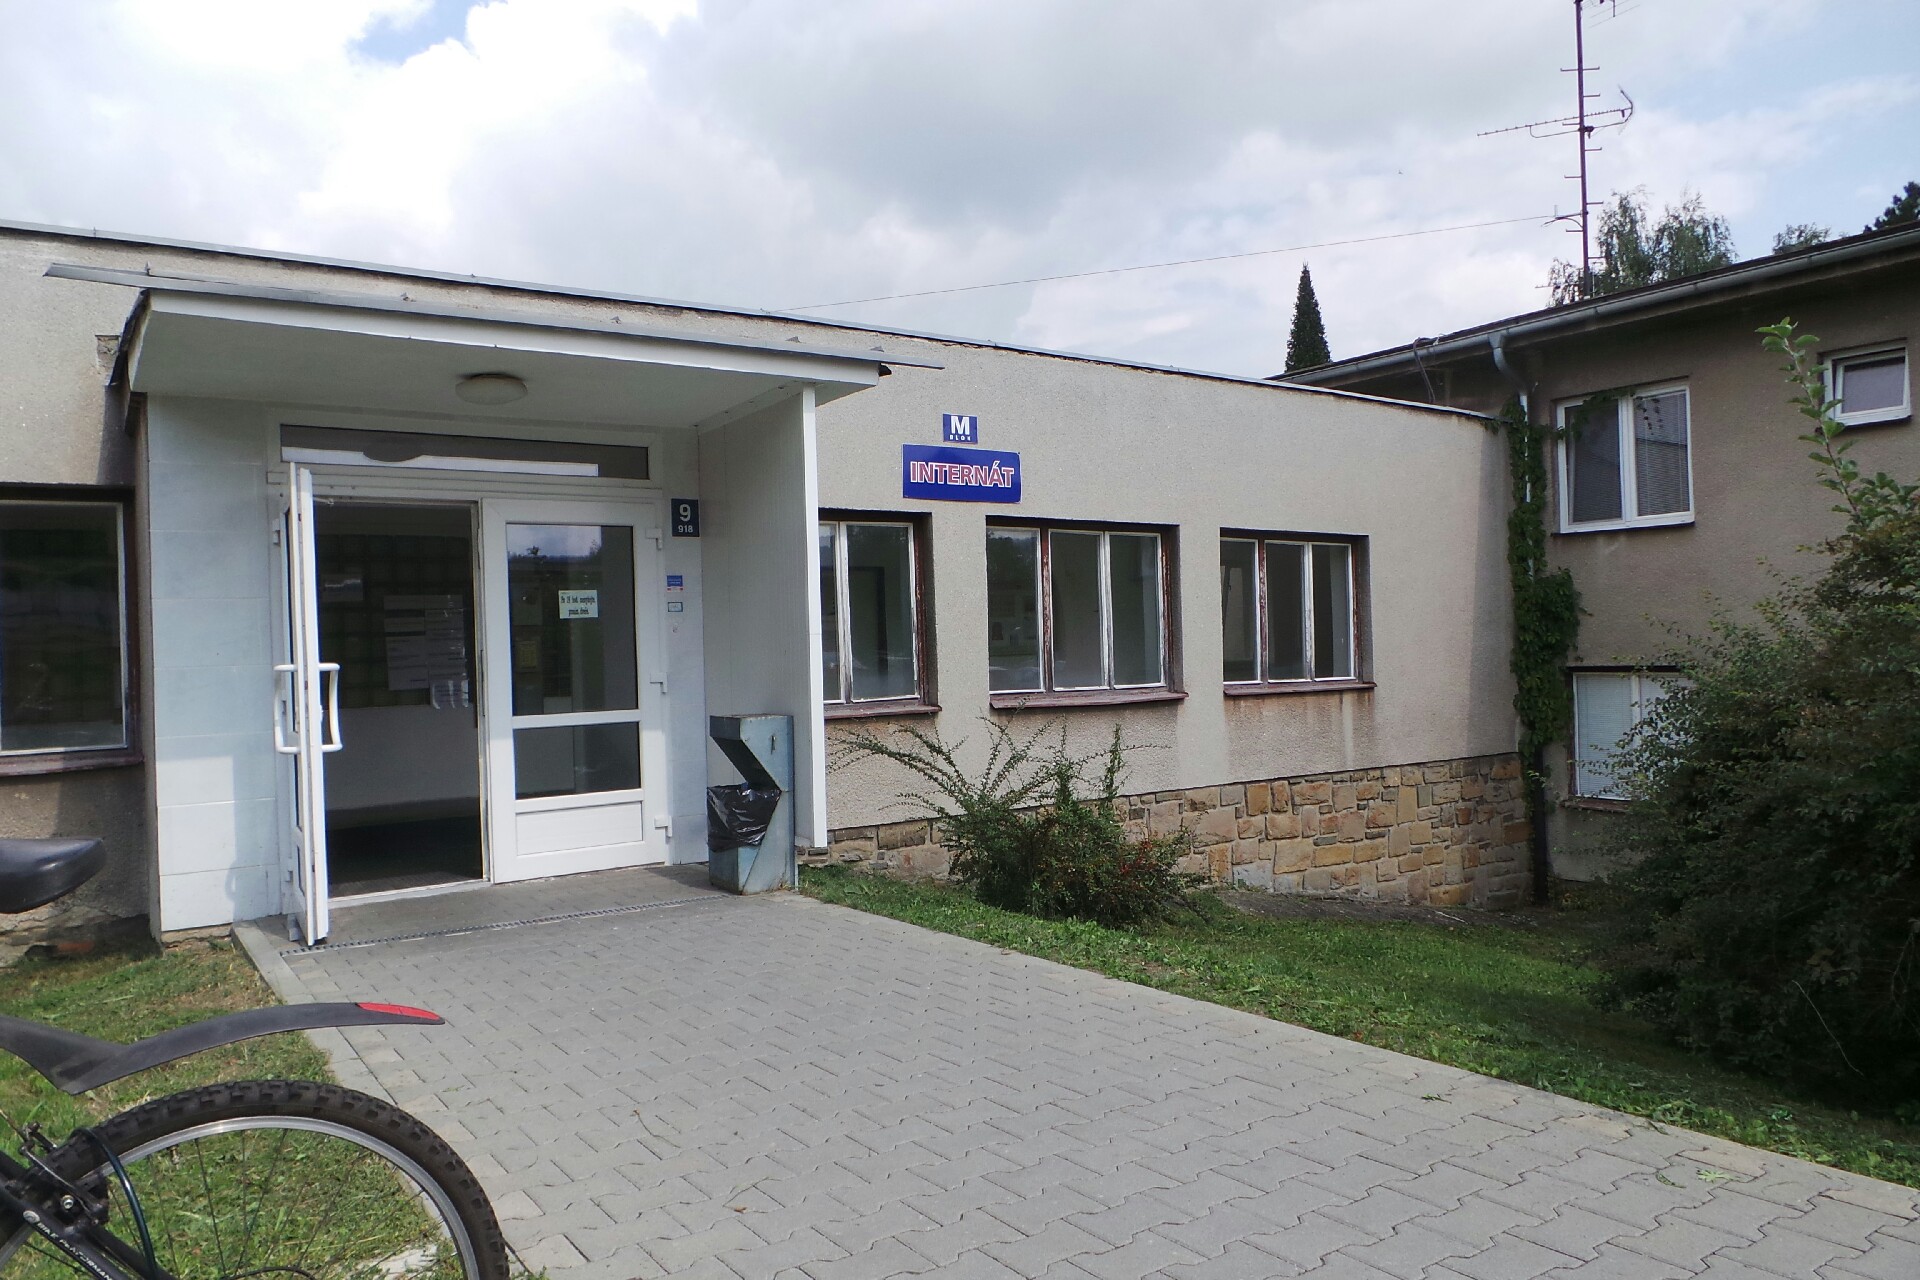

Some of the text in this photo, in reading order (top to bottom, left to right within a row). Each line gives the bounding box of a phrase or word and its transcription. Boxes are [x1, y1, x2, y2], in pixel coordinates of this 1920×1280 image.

[950, 416, 970, 435] M
[910, 461, 1014, 488] INTERNÁT
[679, 504, 691, 522] 9
[678, 525, 694, 533] 918
